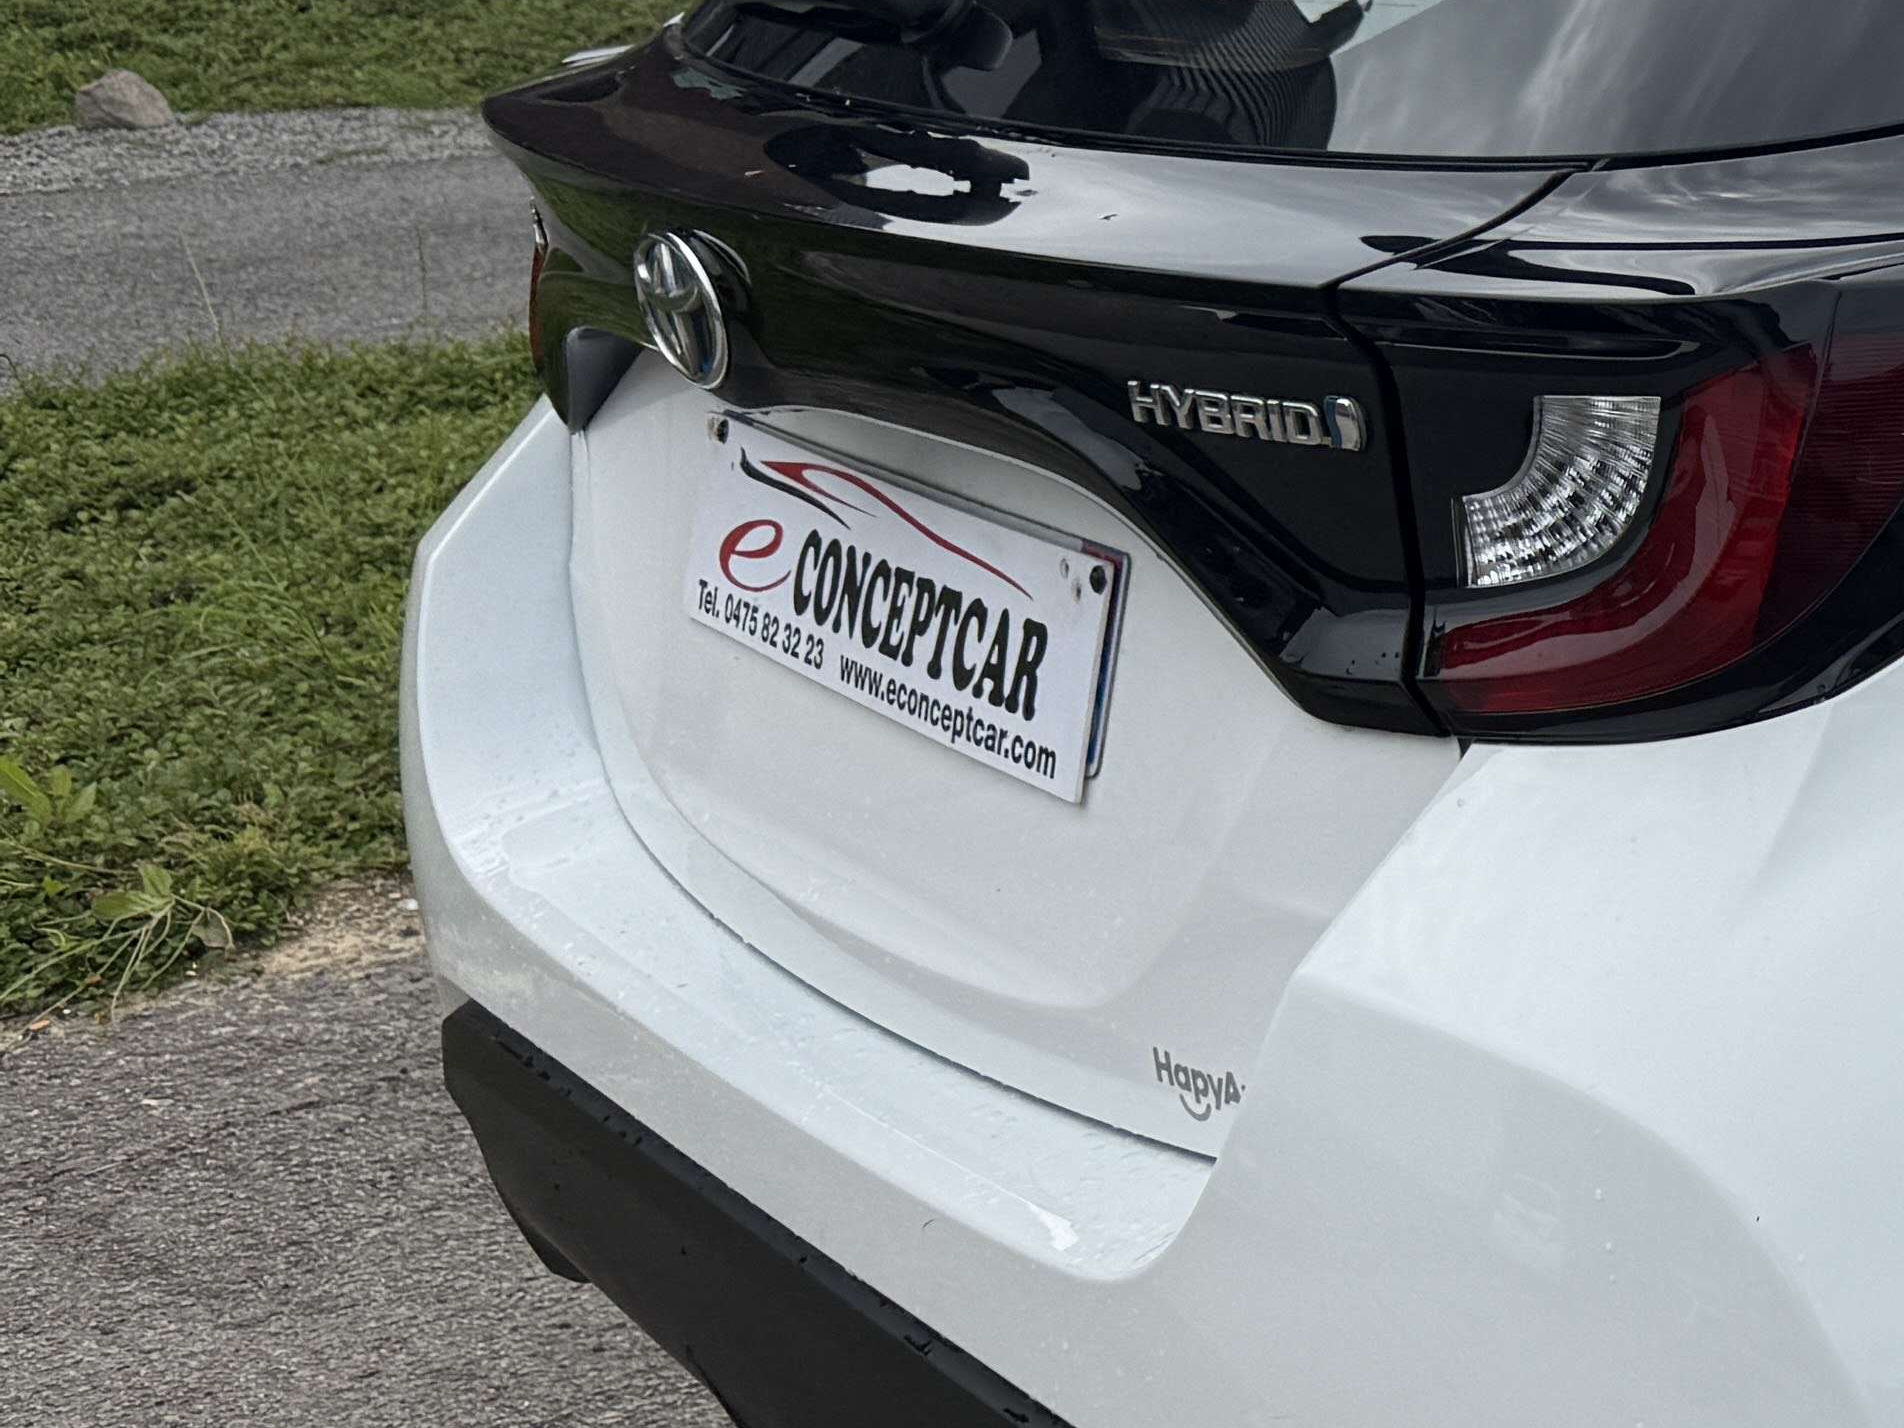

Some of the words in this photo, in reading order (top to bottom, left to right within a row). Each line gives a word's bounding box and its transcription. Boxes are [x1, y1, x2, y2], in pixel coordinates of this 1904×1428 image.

[1128, 380, 1323, 446] HYBRID
[699, 579, 720, 618] Tel.
[725, 593, 759, 636] 0475
[761, 612, 780, 648] 82
[782, 623, 800, 660] 32
[804, 634, 824, 670] 23
[840, 655, 1057, 780] www.econceptcar.com
